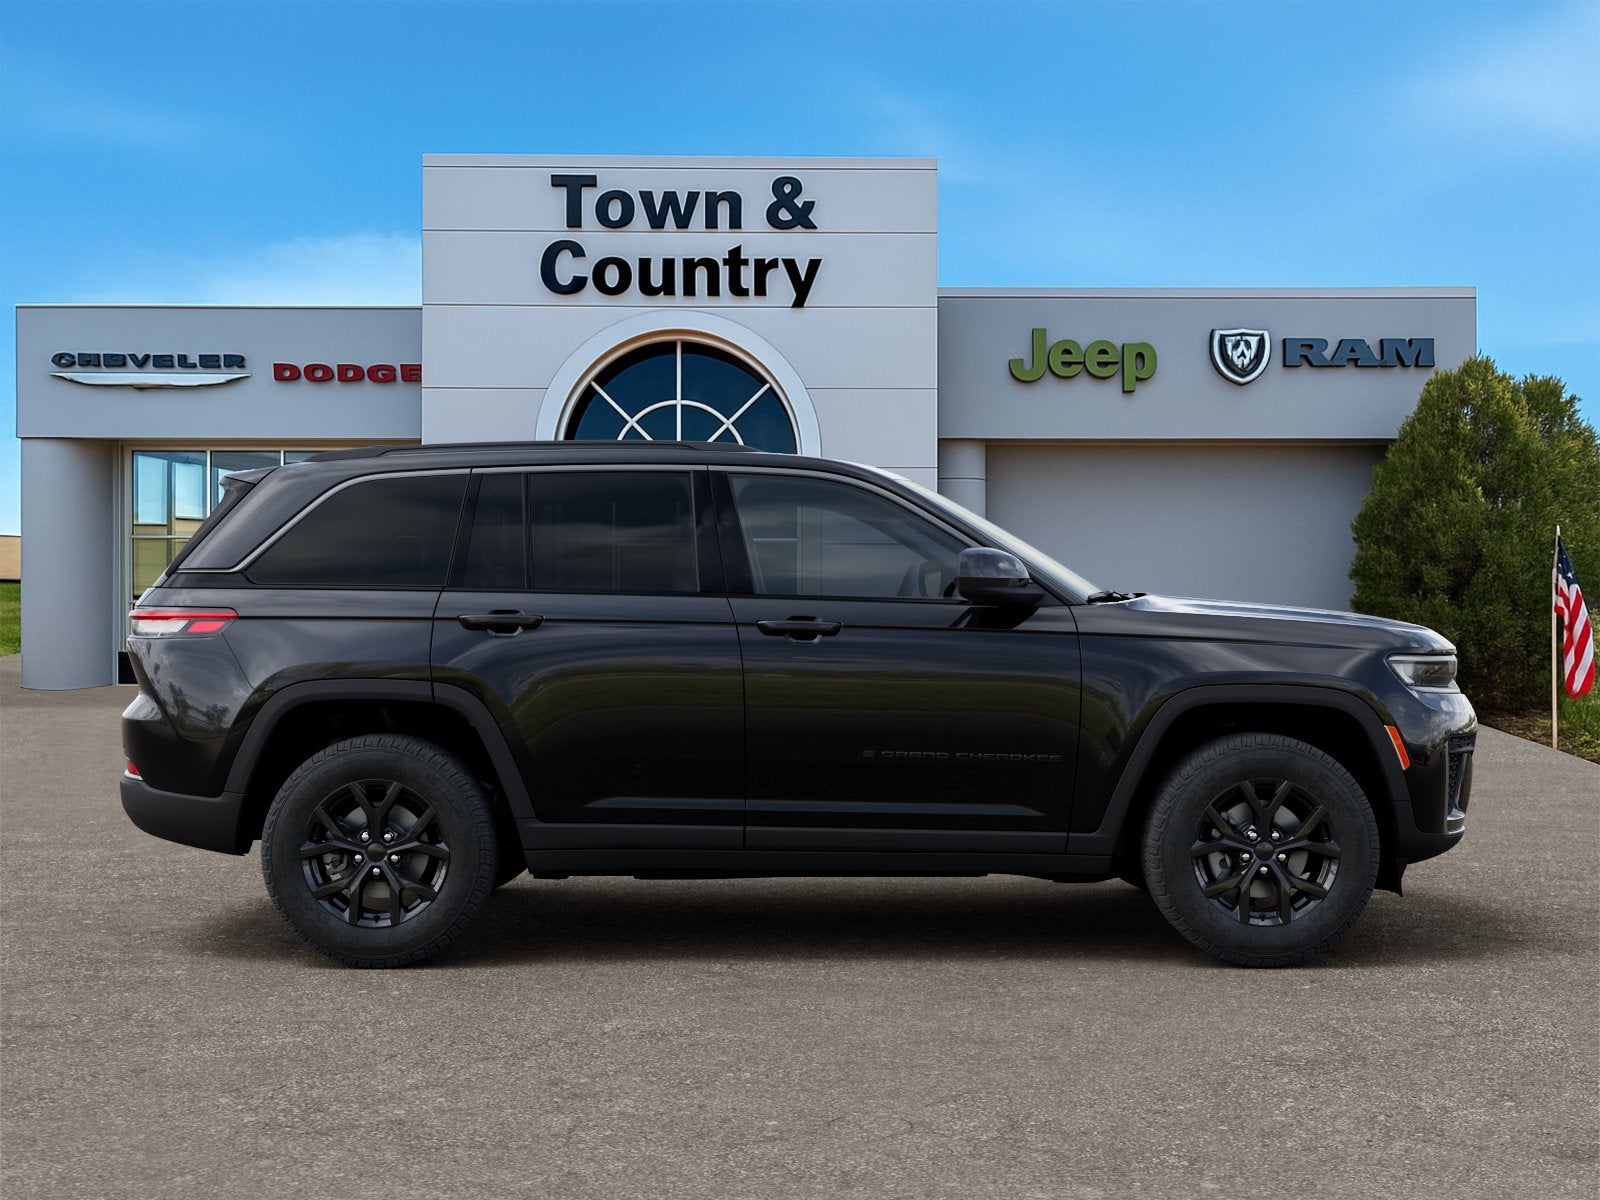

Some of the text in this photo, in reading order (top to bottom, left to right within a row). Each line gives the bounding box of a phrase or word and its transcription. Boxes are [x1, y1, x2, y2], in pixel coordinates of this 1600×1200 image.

[550, 174, 818, 229] Town &
[540, 239, 822, 308] Country
[272, 362, 422, 383] DODGE
[1009, 327, 1158, 393] Jeep
[1282, 337, 1435, 368] RAM
[881, 751, 1063, 762] GRAND CHEROKEE
